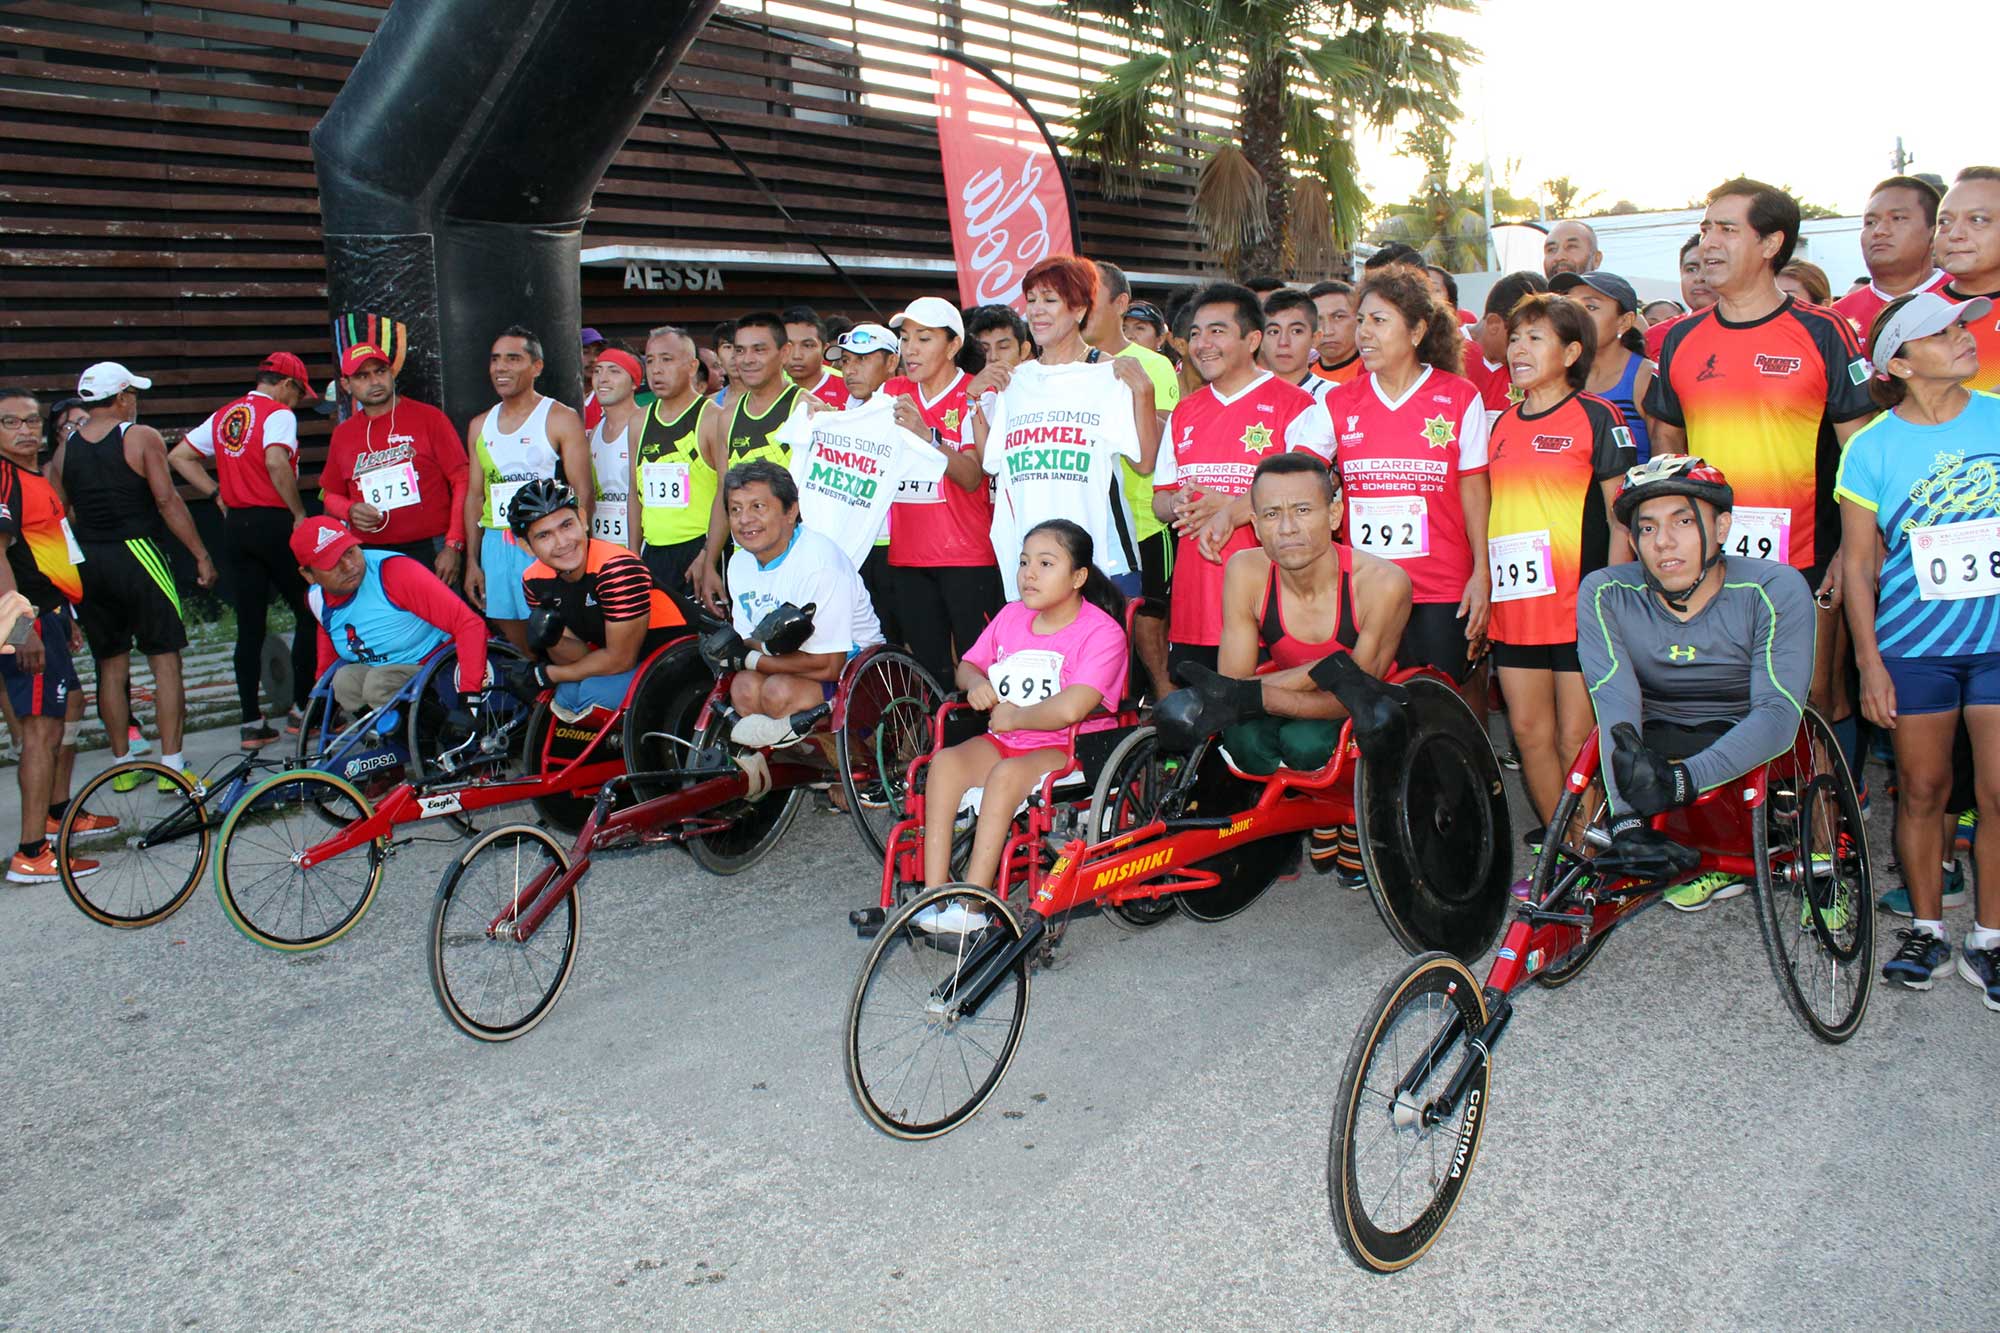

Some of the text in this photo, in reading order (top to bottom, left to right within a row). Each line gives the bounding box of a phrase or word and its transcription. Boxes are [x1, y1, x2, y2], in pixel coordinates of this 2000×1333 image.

[624, 262, 724, 291] AESSA
[1008, 410, 1101, 429] TODOS SOMOS
[1005, 426, 1087, 450] ROMMEL
[1007, 446, 1091, 476] MÉXICO
[1196, 464, 1256, 475] CARRERA
[1346, 460, 1444, 473] XXI CARRERA
[809, 462, 877, 499] MÉXIO
[1359, 472, 1447, 483] INTERNACIONAL
[1362, 482, 1417, 491] BOMBERO
[372, 482, 409, 503] 875
[650, 482, 680, 498] 138
[595, 518, 621, 535] 955
[1361, 523, 1414, 546] 292
[1497, 560, 1538, 588] 295
[1930, 551, 2000, 585] 038
[999, 675, 1052, 700] 695
[556, 727, 598, 741] ORIMA
[360, 753, 397, 772] DIPSA
[428, 798, 454, 810] Eagle
[1093, 847, 1173, 890] NISHIKI
[1450, 1089, 1481, 1179] CORIMA
